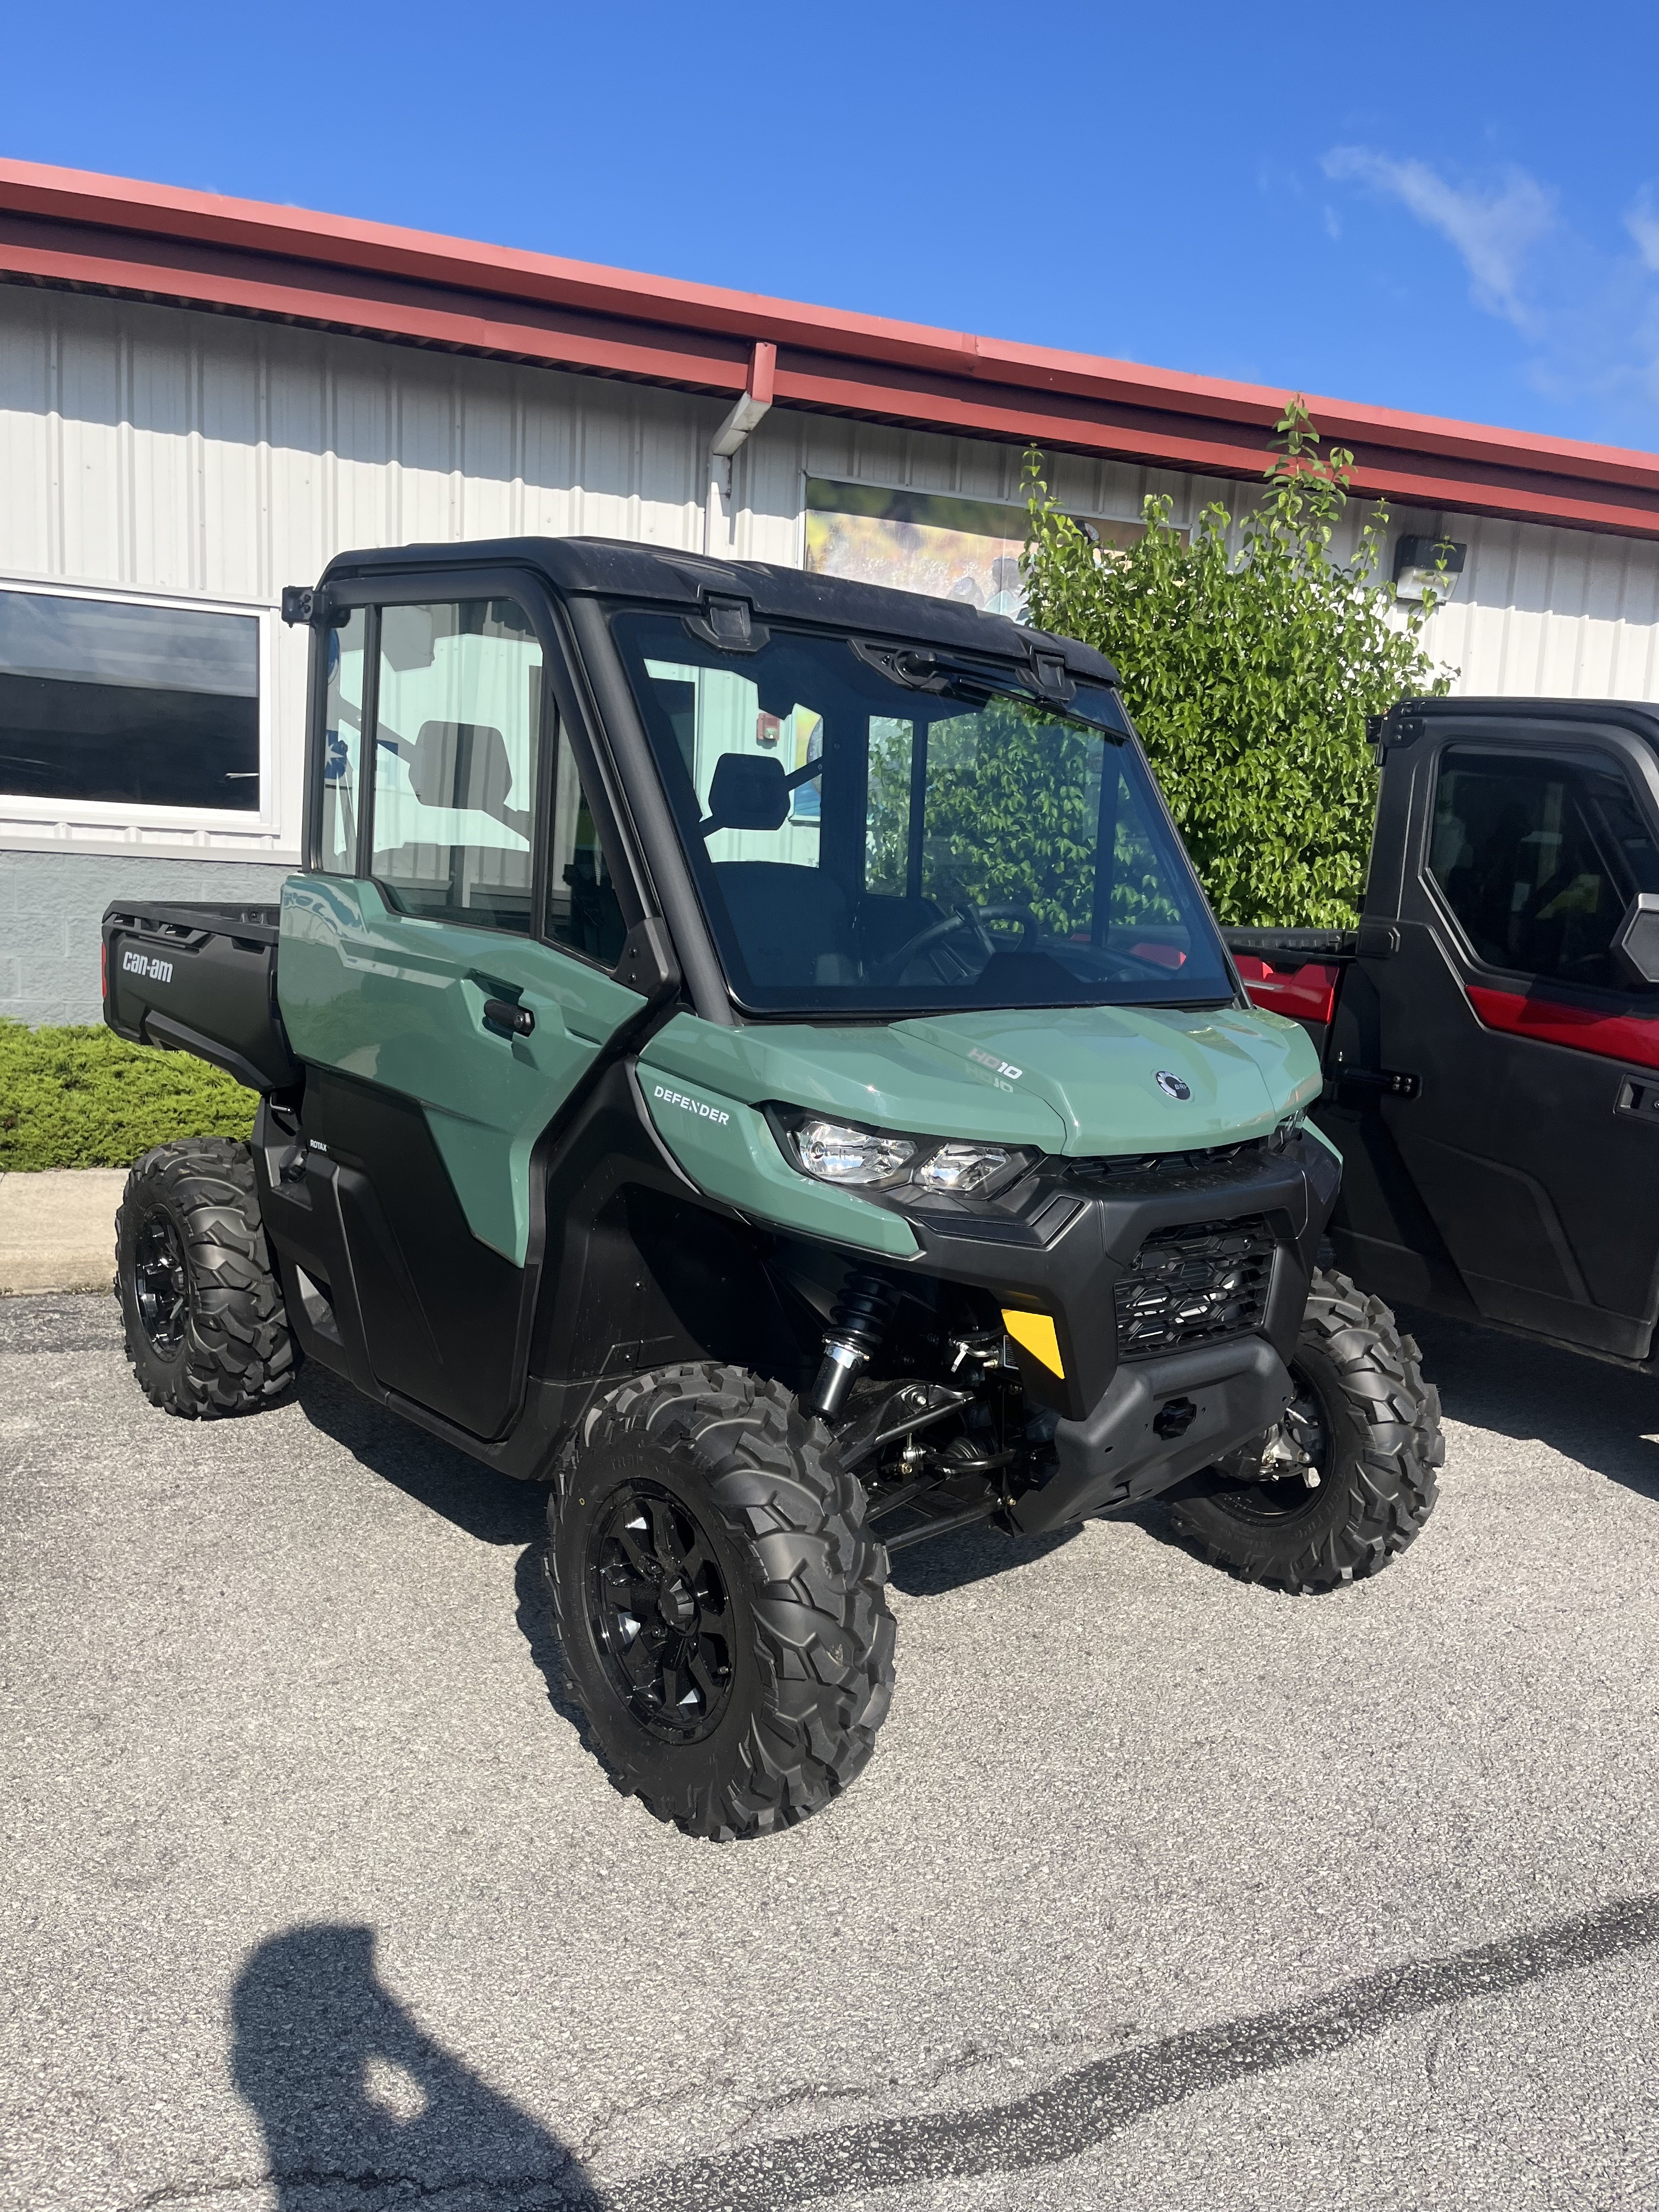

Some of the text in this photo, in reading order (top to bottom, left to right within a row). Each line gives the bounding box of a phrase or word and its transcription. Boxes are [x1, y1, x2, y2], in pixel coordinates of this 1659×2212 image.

[123, 951, 173, 983] can-am
[968, 1047, 1023, 1079] HD10
[654, 1085, 729, 1125] DEFENDER
[310, 1139, 327, 1152] ROTAX
